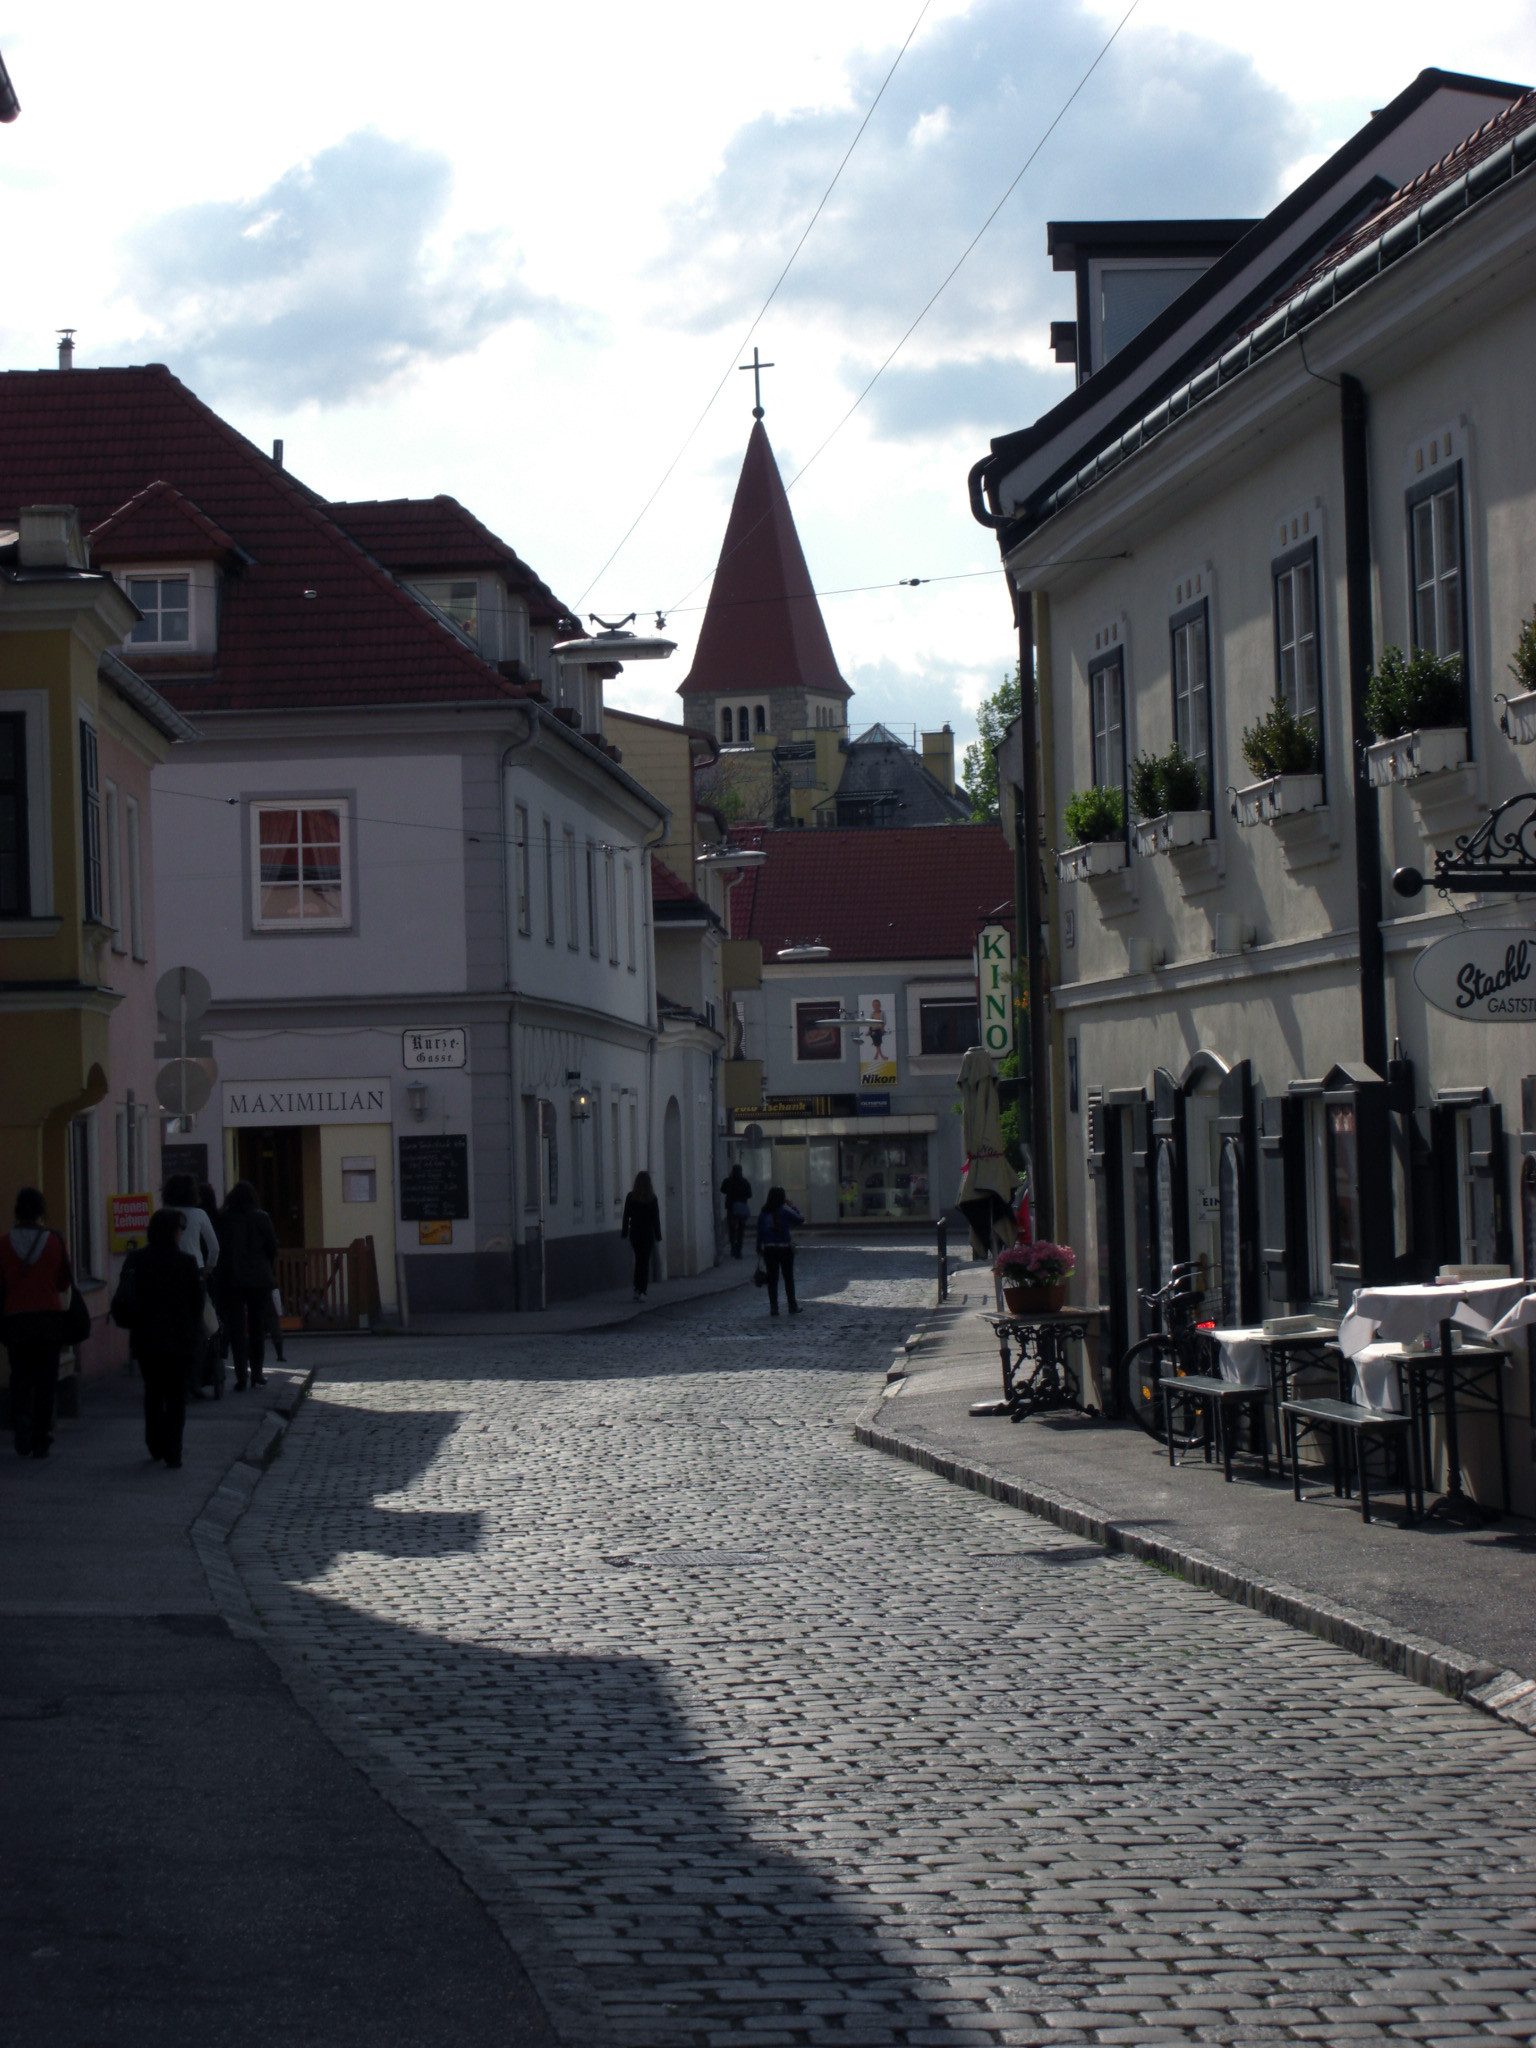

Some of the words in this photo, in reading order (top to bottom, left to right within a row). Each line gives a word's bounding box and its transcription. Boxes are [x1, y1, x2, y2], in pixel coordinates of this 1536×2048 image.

[982, 934, 1008, 1050] KINO
[862, 1074, 896, 1084] Nikon
[230, 1091, 384, 1113] MAXIMILIAN
[113, 1201, 148, 1214] Kronen
